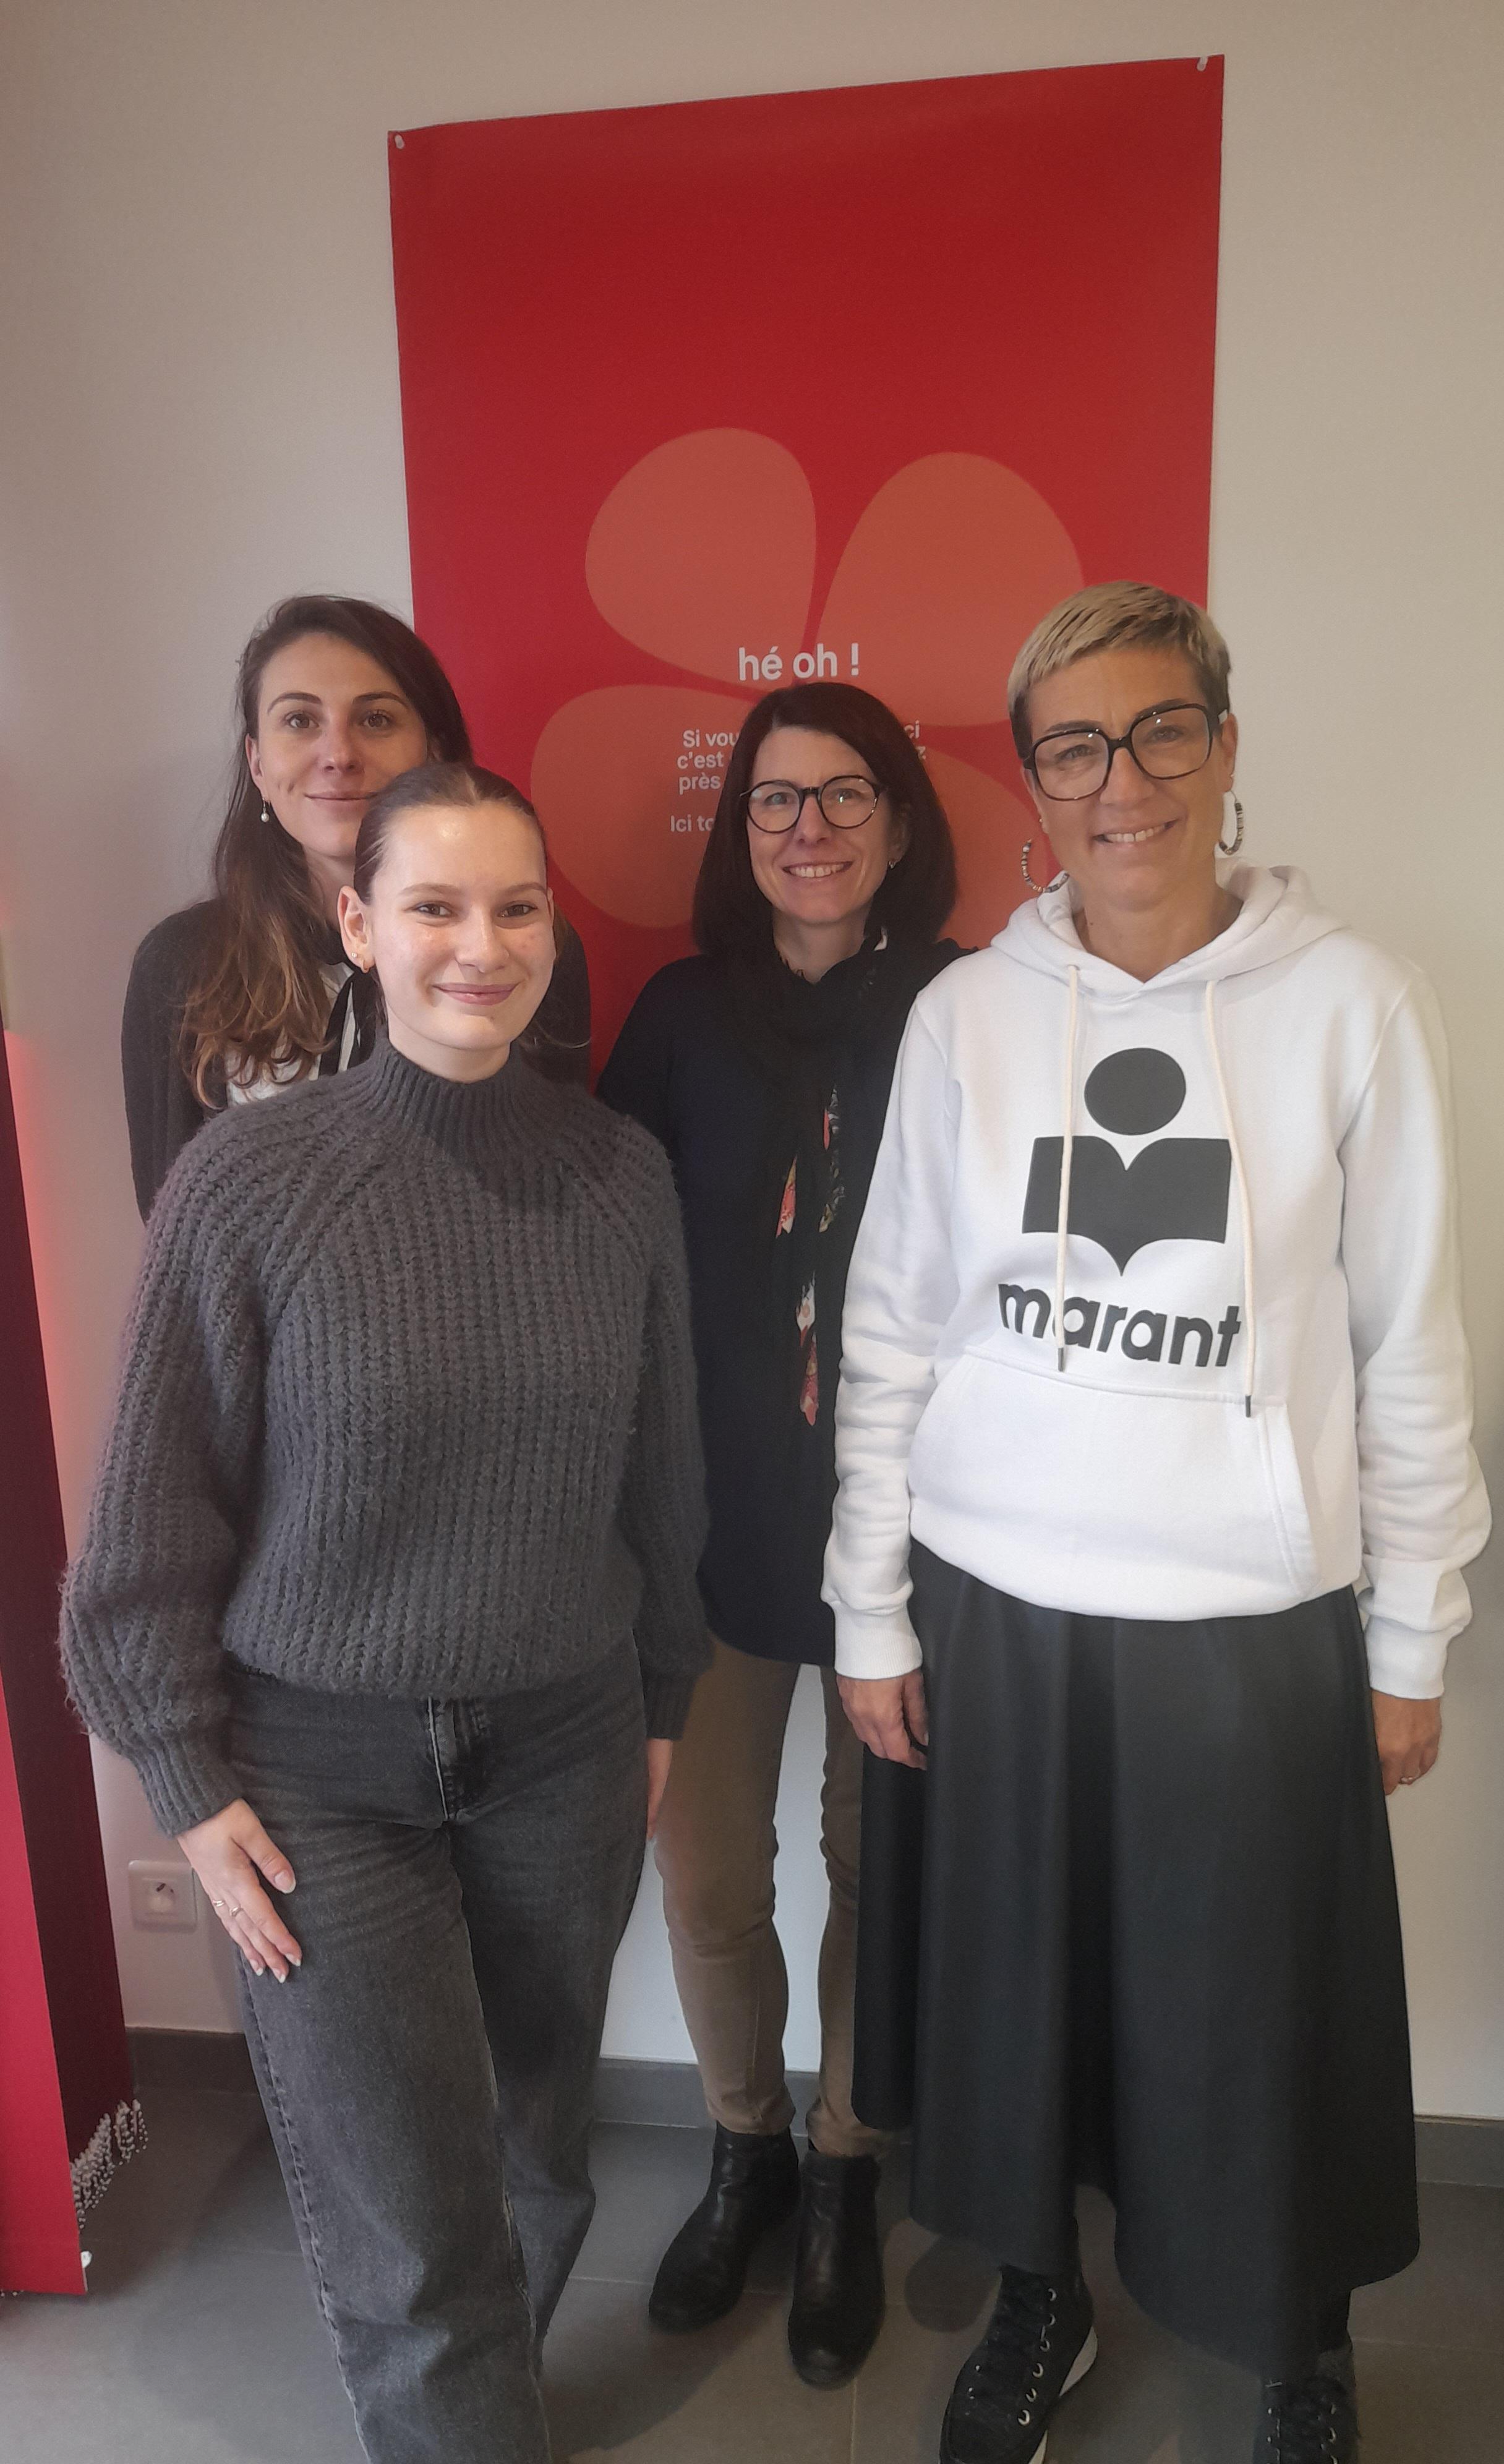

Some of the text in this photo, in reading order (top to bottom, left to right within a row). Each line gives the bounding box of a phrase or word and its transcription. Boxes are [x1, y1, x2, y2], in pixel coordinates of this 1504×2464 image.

[738, 643, 859, 681] hé oh !
[683, 729, 700, 748] Si
[706, 732, 740, 747] vou
[677, 751, 724, 769] c'est
[679, 772, 721, 795] près
[670, 814, 714, 832] Ici to
[998, 1283, 1241, 1368] marant
